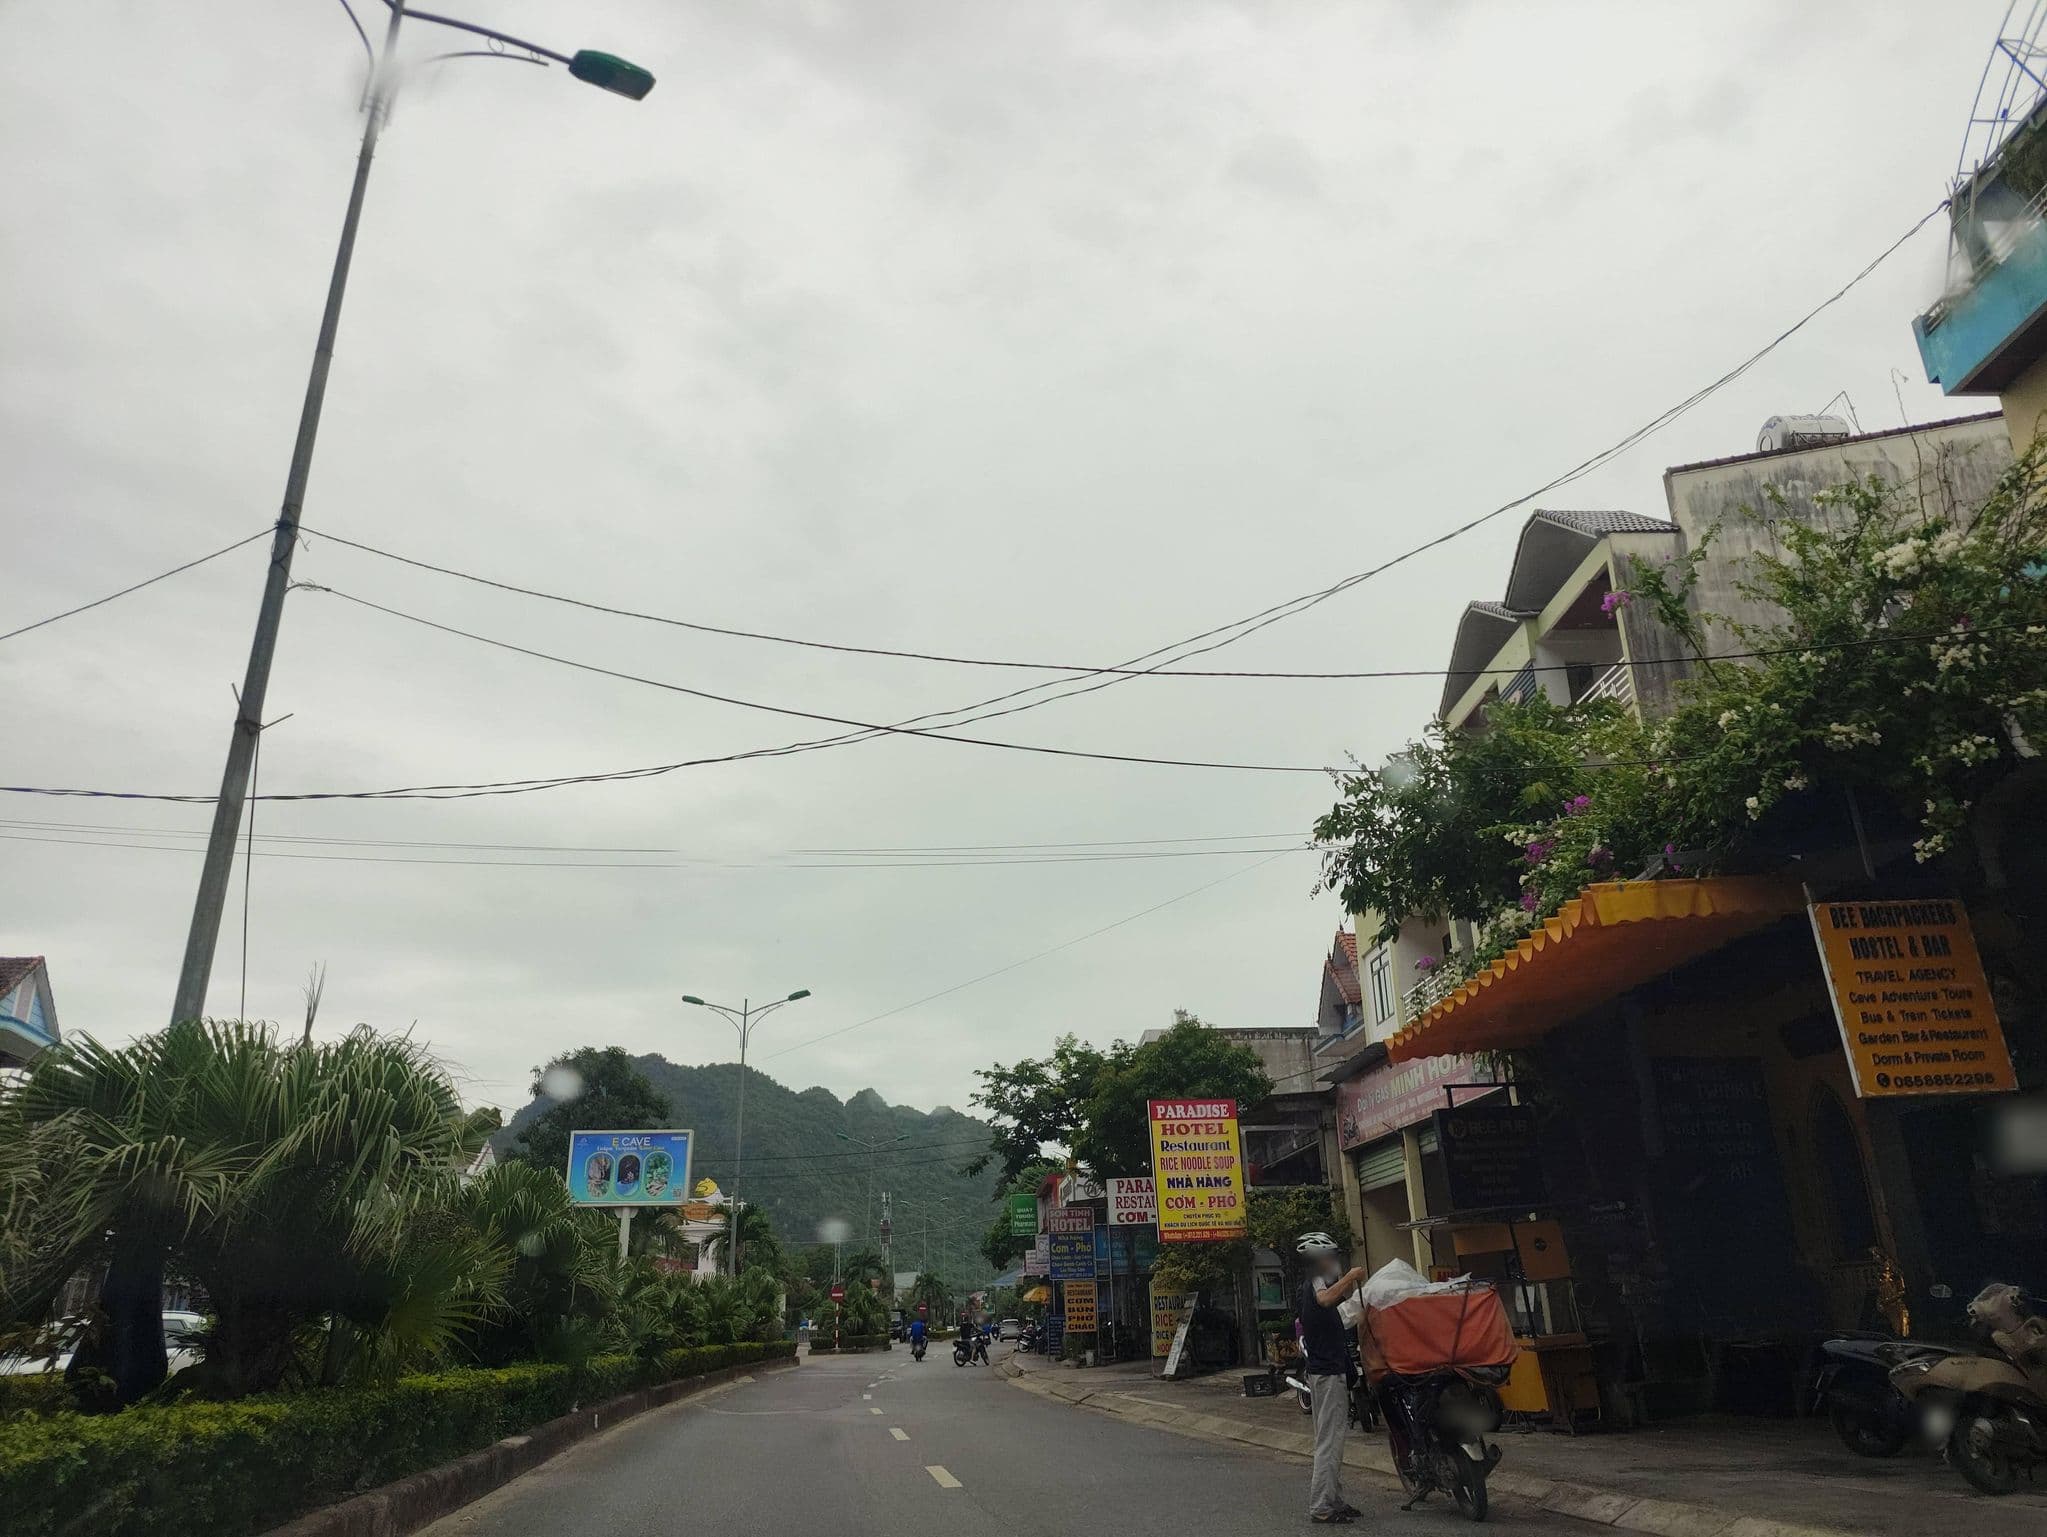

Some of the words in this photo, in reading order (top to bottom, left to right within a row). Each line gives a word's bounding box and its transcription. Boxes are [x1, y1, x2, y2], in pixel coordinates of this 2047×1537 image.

[1849, 936, 1904, 960] HOSTEL
[1856, 969, 1905, 984] TRAVEL
[1909, 967, 1957, 982] AGENCY
[1849, 991, 1876, 1004] Cave
[1882, 989, 1938, 1003] Adventure
[1860, 1011, 1884, 1024] Bus
[1899, 1009, 1927, 1022] Train
[1858, 1031, 1900, 1045] Garden
[1872, 1052, 1903, 1066] Dorm
[1952, 1048, 1986, 1062] Room
[1391, 1063, 1424, 1100] MINH
[1156, 1104, 1230, 1119] PARADISE
[1161, 1122, 1230, 1136] HOTEL
[622, 1137, 651, 1147] CAVE
[1161, 1140, 1231, 1152] Restaurant
[1160, 1157, 1178, 1171] RICE
[1181, 1156, 1211, 1170] NOODLE
[1214, 1155, 1235, 1170] SOUP
[1167, 1174, 1193, 1189] NHÀ
[1196, 1173, 1232, 1188] HÀNG
[1165, 1195, 1196, 1210] CƠM
[1050, 1218, 1091, 1232] HOTEL
[1155, 1313, 1174, 1327] RICE
